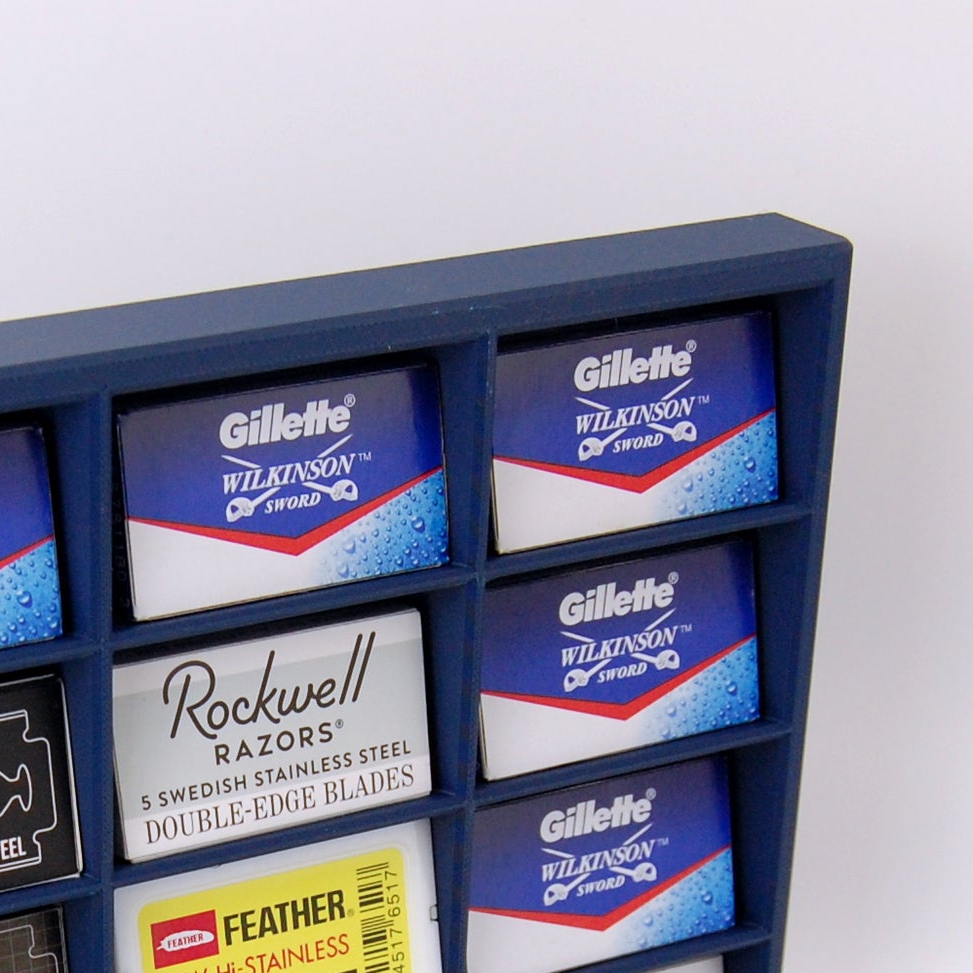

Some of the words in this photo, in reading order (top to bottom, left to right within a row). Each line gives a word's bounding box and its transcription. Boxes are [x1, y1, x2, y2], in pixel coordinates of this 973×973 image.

[576, 396, 695, 435] WILKINSON
[613, 433, 663, 453] SWORD
[222, 453, 355, 494] WILKINSON
[265, 492, 321, 513] SWORD
[561, 626, 678, 667] WILKINSON
[163, 631, 376, 740] Rockwell
[597, 662, 647, 683] SWORD
[142, 795, 151, 810] 5
[159, 775, 247, 807] SWEDISH
[255, 755, 352, 787] STAINLESS
[359, 740, 411, 764] STEEL
[146, 785, 316, 844] DOUBLE-EDGE
[323, 765, 415, 805] BLADES
[541, 840, 655, 882] WILKINSON
[577, 876, 625, 896] SWORD
[223, 890, 345, 946] FEATHER
[167, 930, 204, 949] FEATHER
